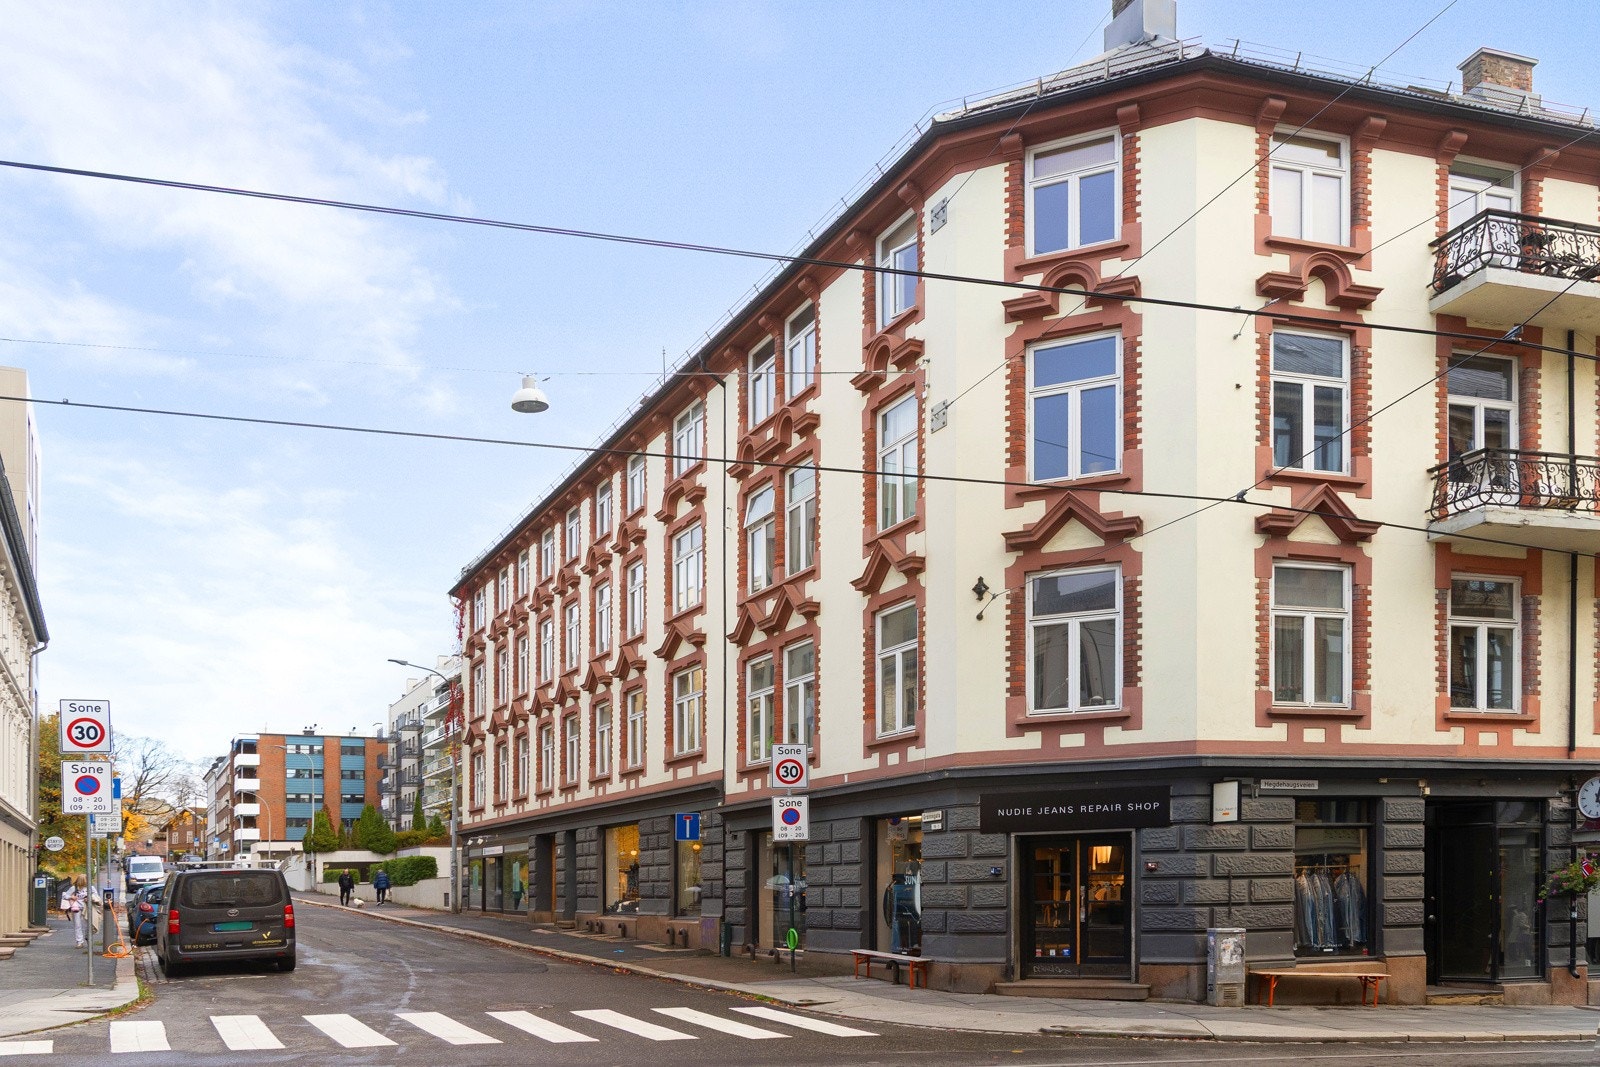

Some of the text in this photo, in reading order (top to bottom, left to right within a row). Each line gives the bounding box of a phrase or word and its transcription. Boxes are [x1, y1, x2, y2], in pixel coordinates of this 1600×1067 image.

[69, 702, 101, 712] Sone
[74, 725, 98, 740] 30
[778, 746, 802, 755] Sone
[71, 764, 104, 774] Sone
[781, 765, 799, 778] 30
[779, 799, 802, 808] Sone
[998, 802, 1160, 816] NUDIE JEANS REPAIR SHOP
